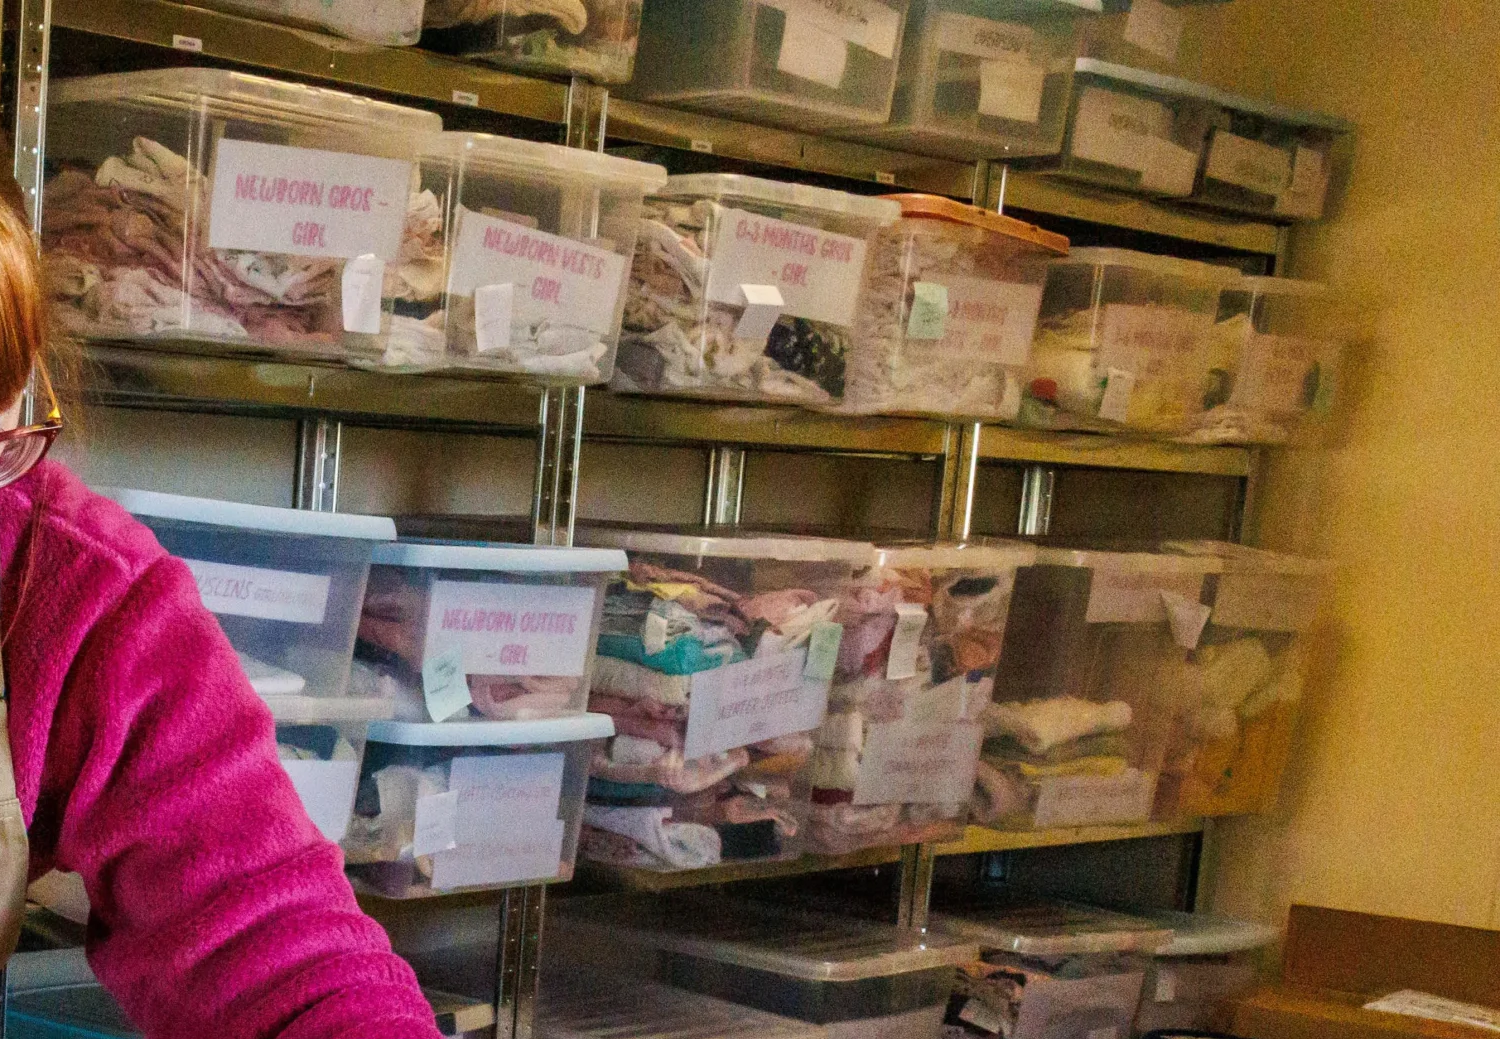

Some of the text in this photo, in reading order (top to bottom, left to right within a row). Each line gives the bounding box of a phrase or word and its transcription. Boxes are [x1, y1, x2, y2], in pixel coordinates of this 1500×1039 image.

[234, 173, 324, 206] NEWBORN
[292, 220, 326, 247] GIRL
[483, 225, 559, 267] NEWBORN
[763, 225, 818, 256] MONTHS
[441, 606, 579, 635] NEWBORN OUTFITS
